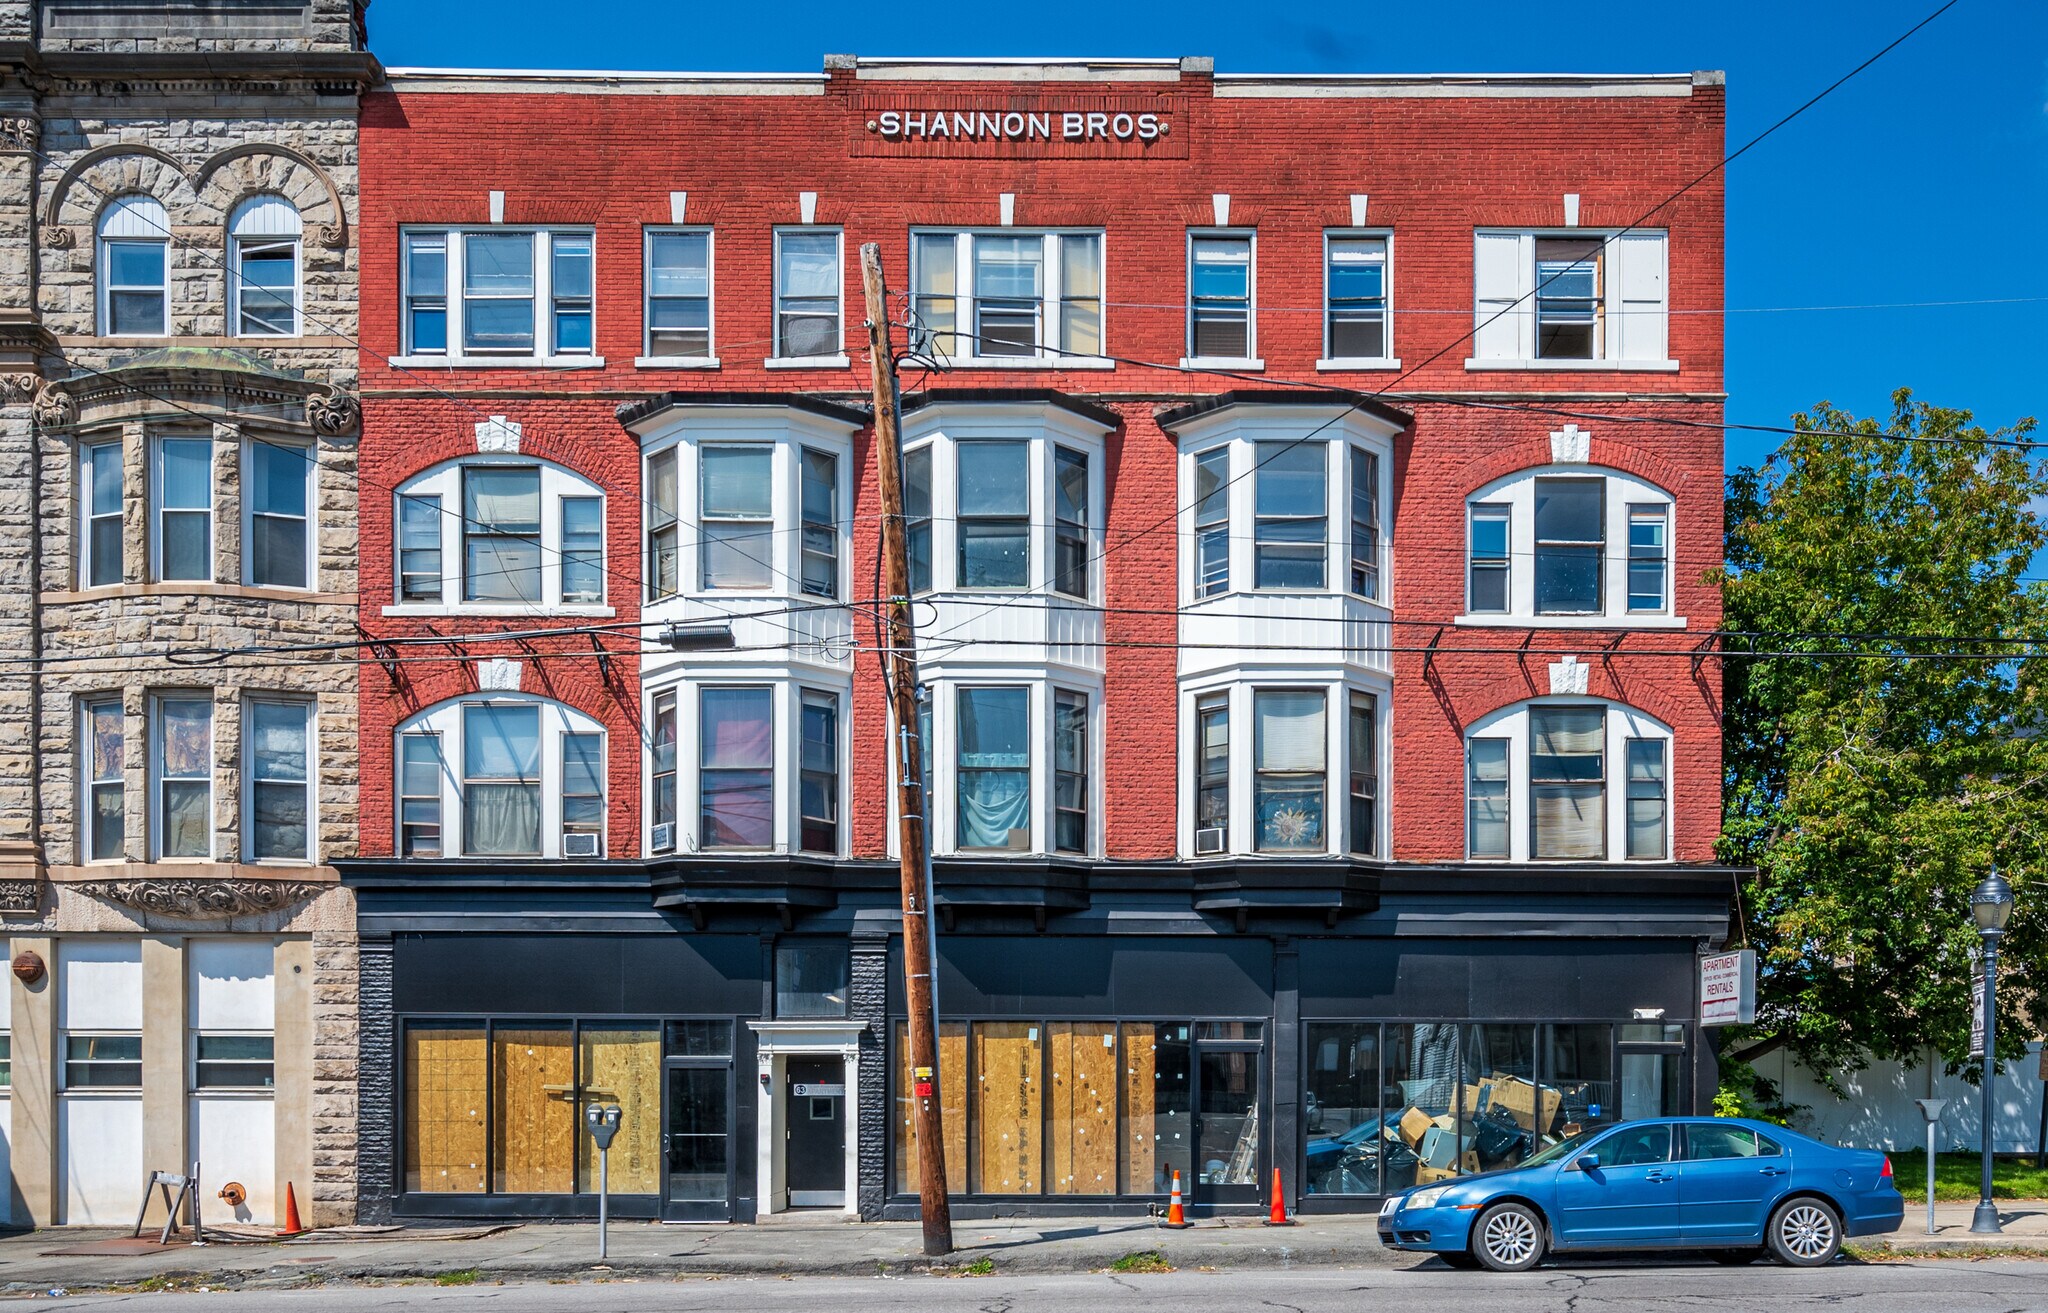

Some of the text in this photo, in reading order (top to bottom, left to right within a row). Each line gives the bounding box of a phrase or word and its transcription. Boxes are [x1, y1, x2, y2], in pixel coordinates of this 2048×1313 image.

[879, 111, 1159, 138] SHANNON BROS
[1703, 956, 1738, 972] APARTMENT
[1707, 981, 1733, 995] RENTALS
